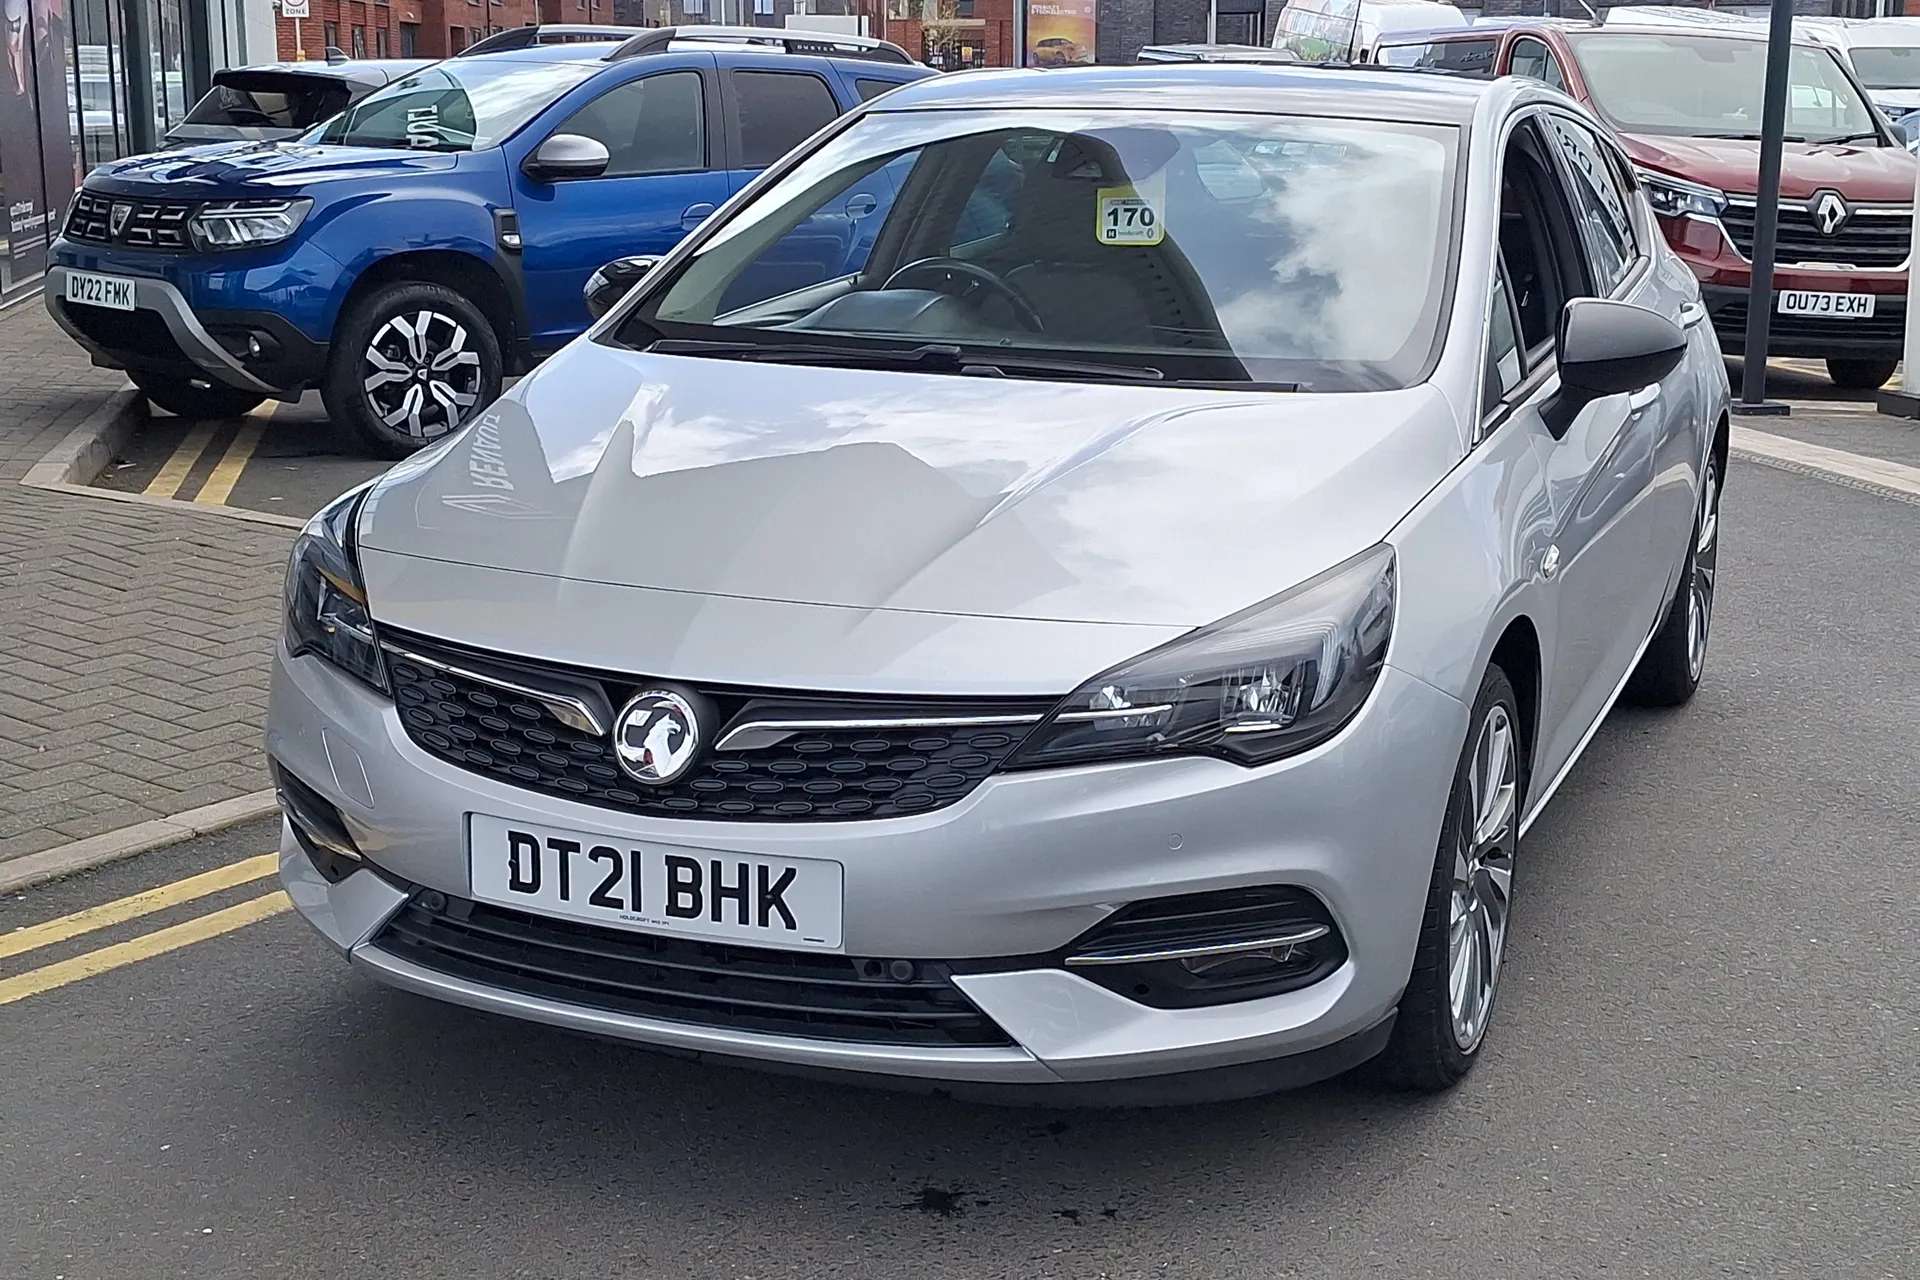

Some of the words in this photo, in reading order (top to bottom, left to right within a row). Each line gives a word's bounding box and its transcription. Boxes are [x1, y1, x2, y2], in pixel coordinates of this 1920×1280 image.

[1107, 207, 1155, 227] 170
[71, 275, 102, 301] DY22
[104, 280, 130, 306] FMK
[1786, 293, 1831, 311] OU73
[1835, 295, 1868, 313] EXH
[507, 829, 643, 914] DT21
[665, 853, 798, 931] BHK
